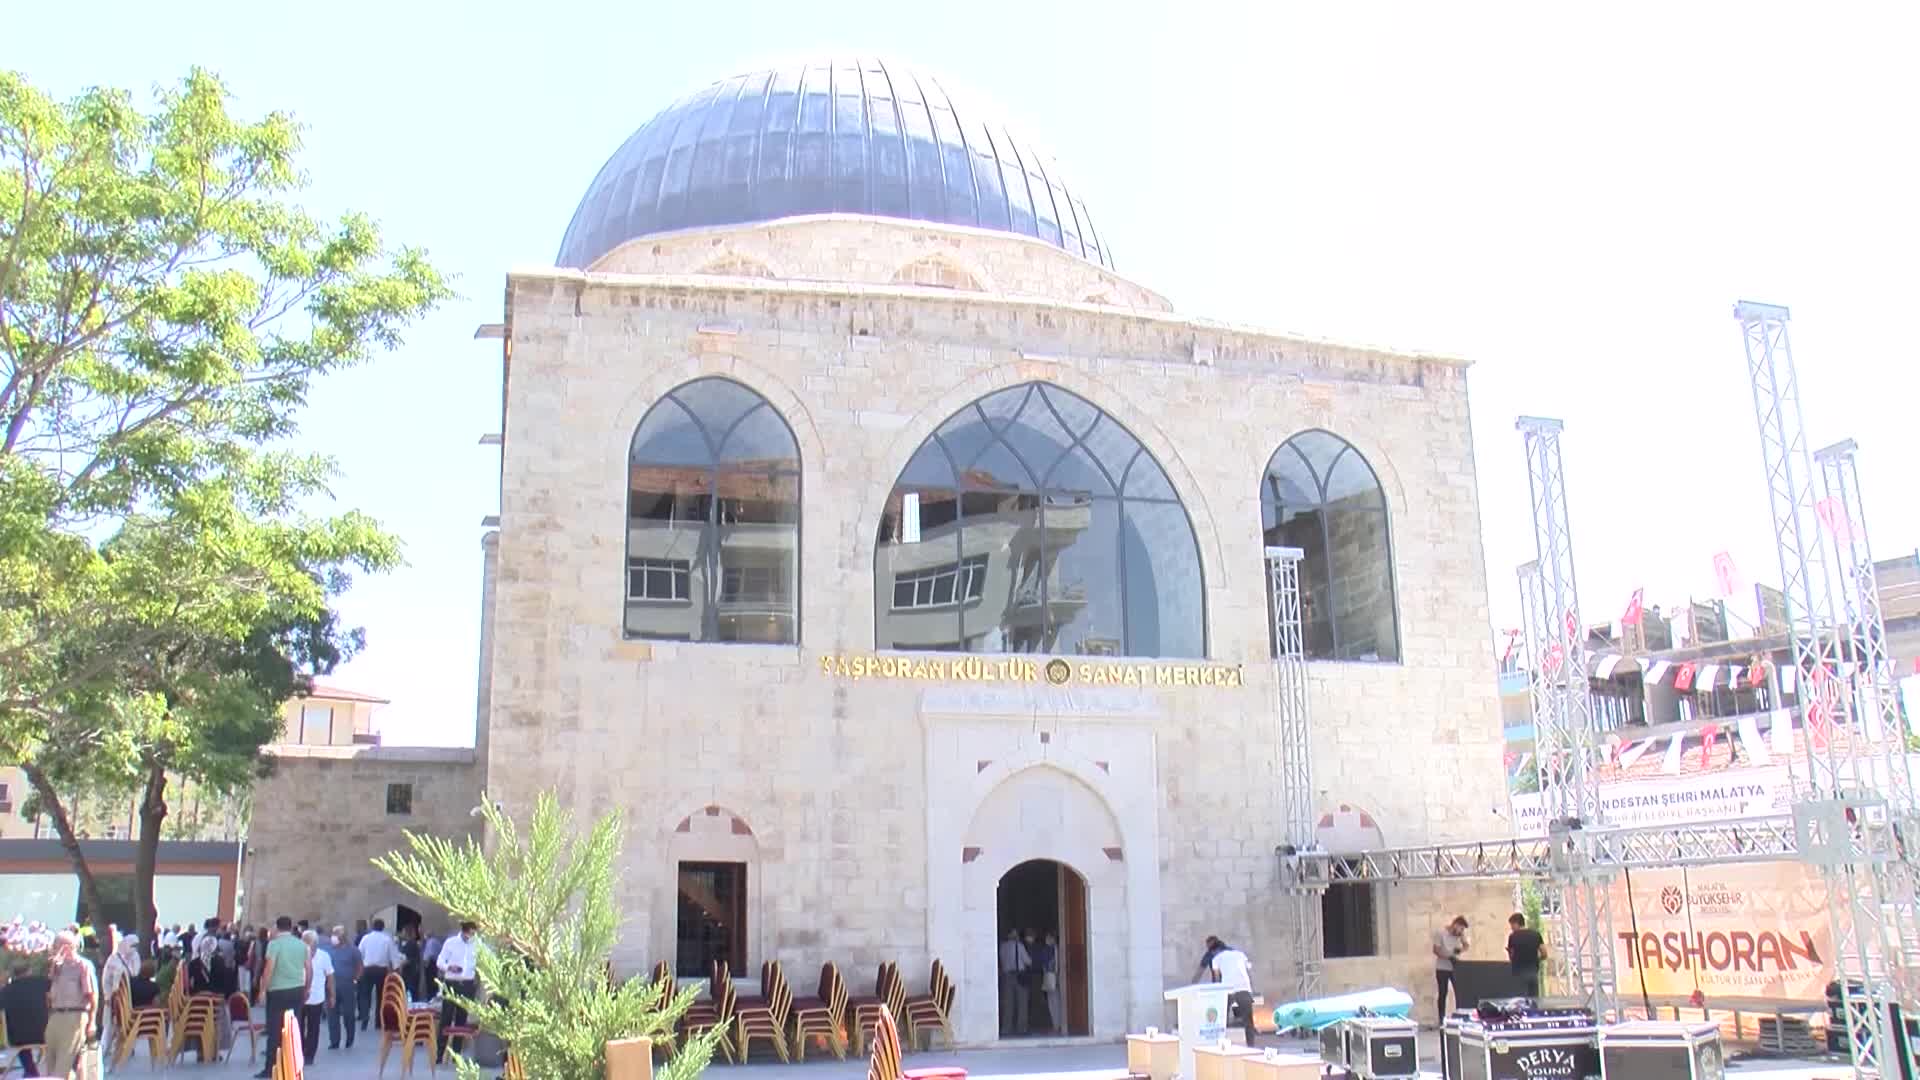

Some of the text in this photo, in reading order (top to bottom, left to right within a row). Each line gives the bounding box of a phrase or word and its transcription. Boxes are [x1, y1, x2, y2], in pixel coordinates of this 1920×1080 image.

[821, 655, 1247, 686] TAŞHORAN KÜLTÜR SANAT MERKEZİ
[1612, 795, 1658, 809] DESTAN
[1701, 785, 1765, 801] MALATYA
[1618, 930, 1823, 973] TAŞHORAN
[1516, 1048, 1576, 1071] DERYA
[1527, 1066, 1572, 1076] SOUND
